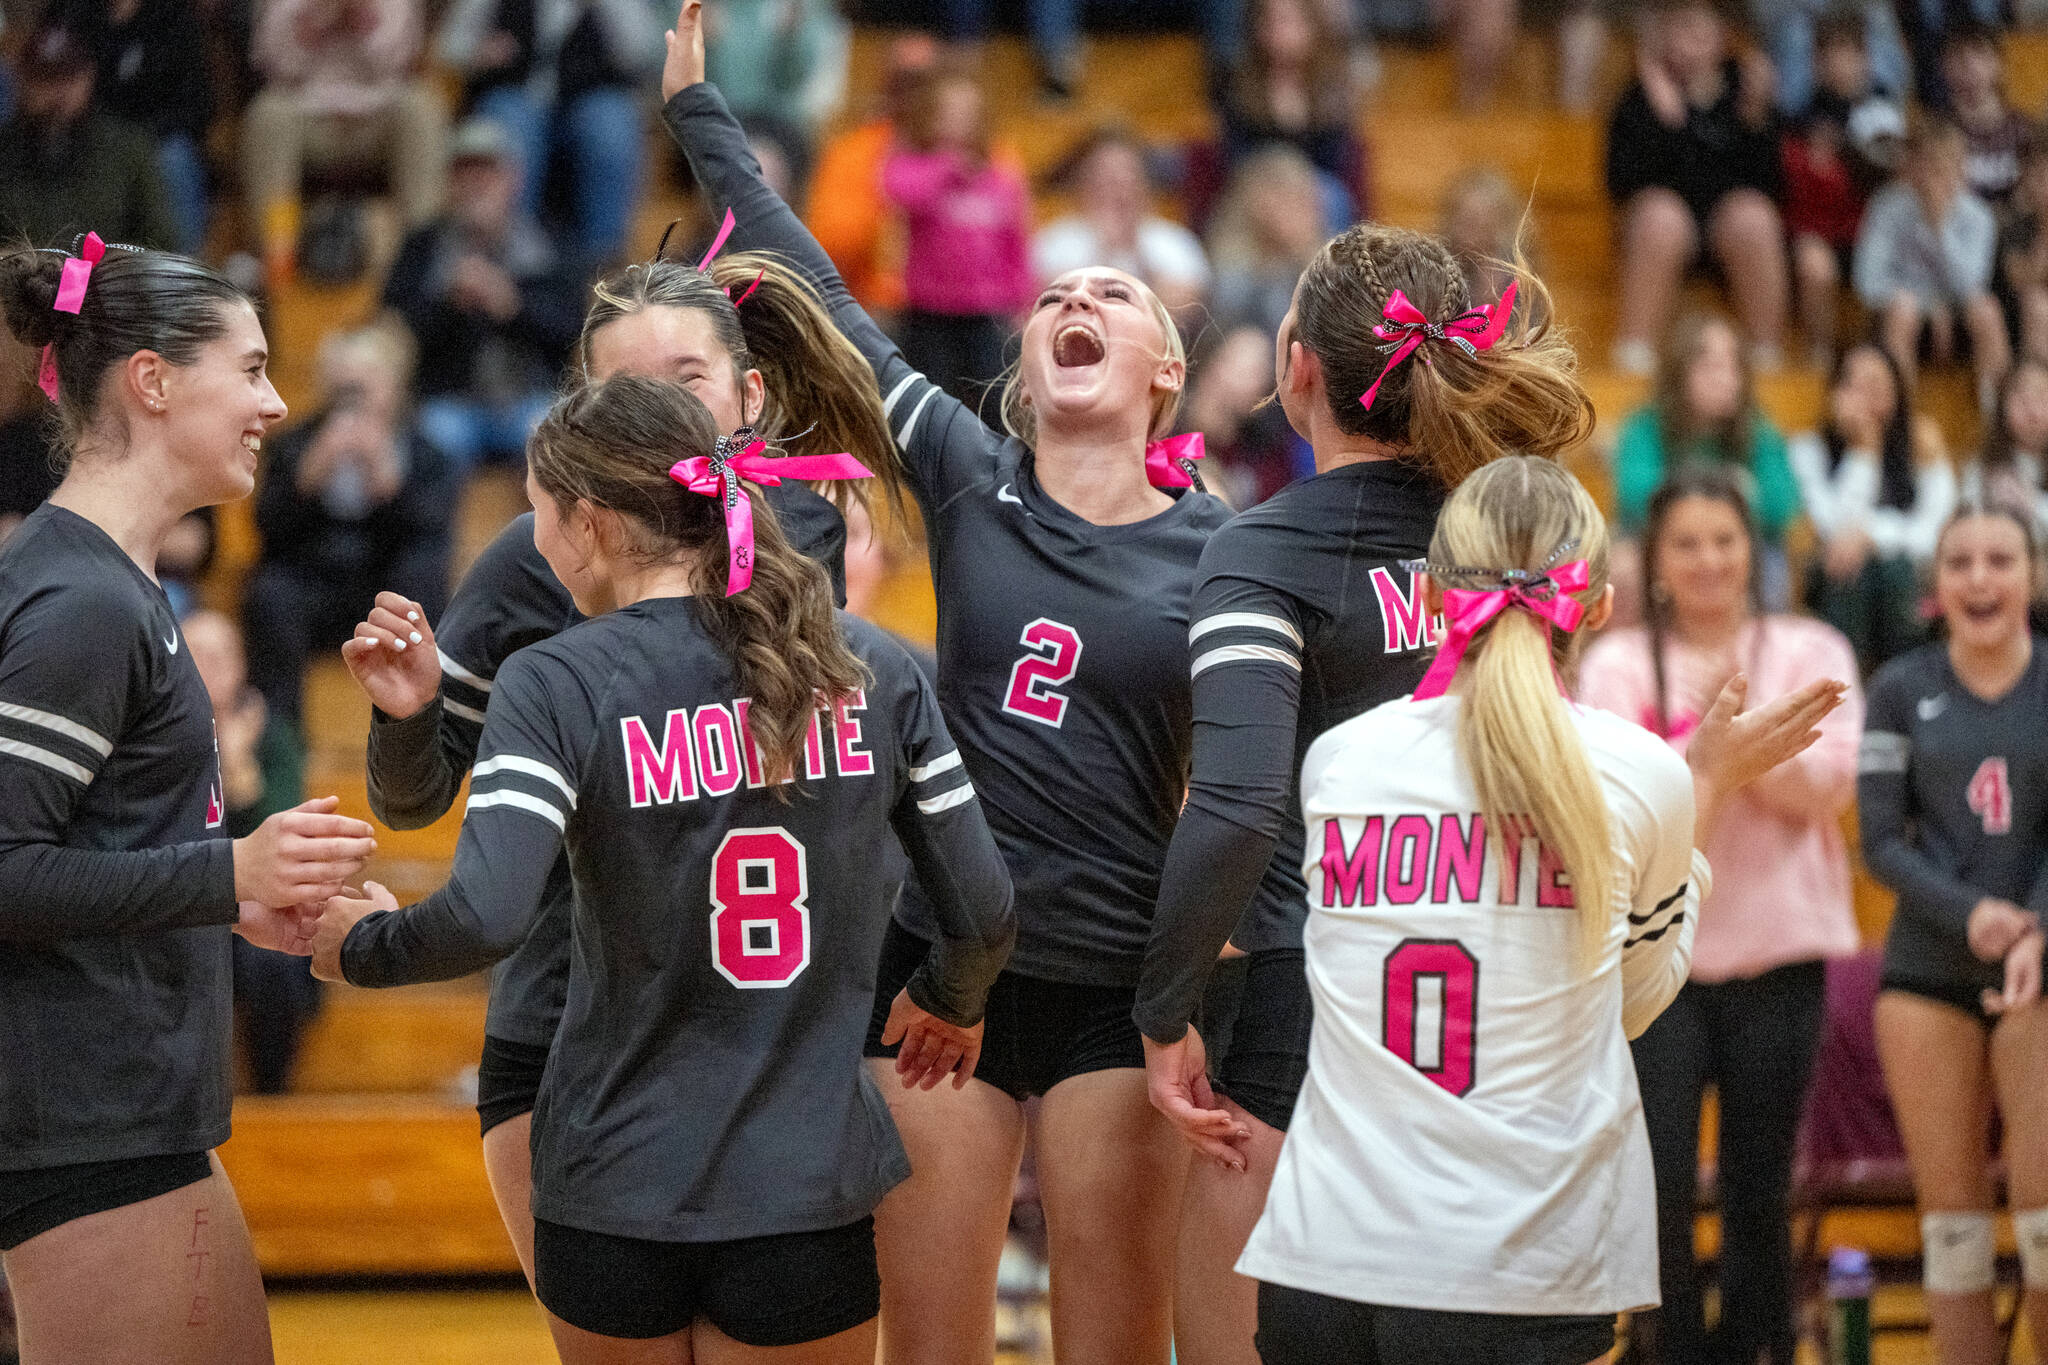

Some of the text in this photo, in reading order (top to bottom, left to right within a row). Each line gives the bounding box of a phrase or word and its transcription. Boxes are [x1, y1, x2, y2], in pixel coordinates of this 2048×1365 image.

[1002, 617, 1084, 729] 2
[1966, 755, 2012, 834] 4
[709, 826, 811, 989] 8
[1381, 937, 1480, 1099] 0
